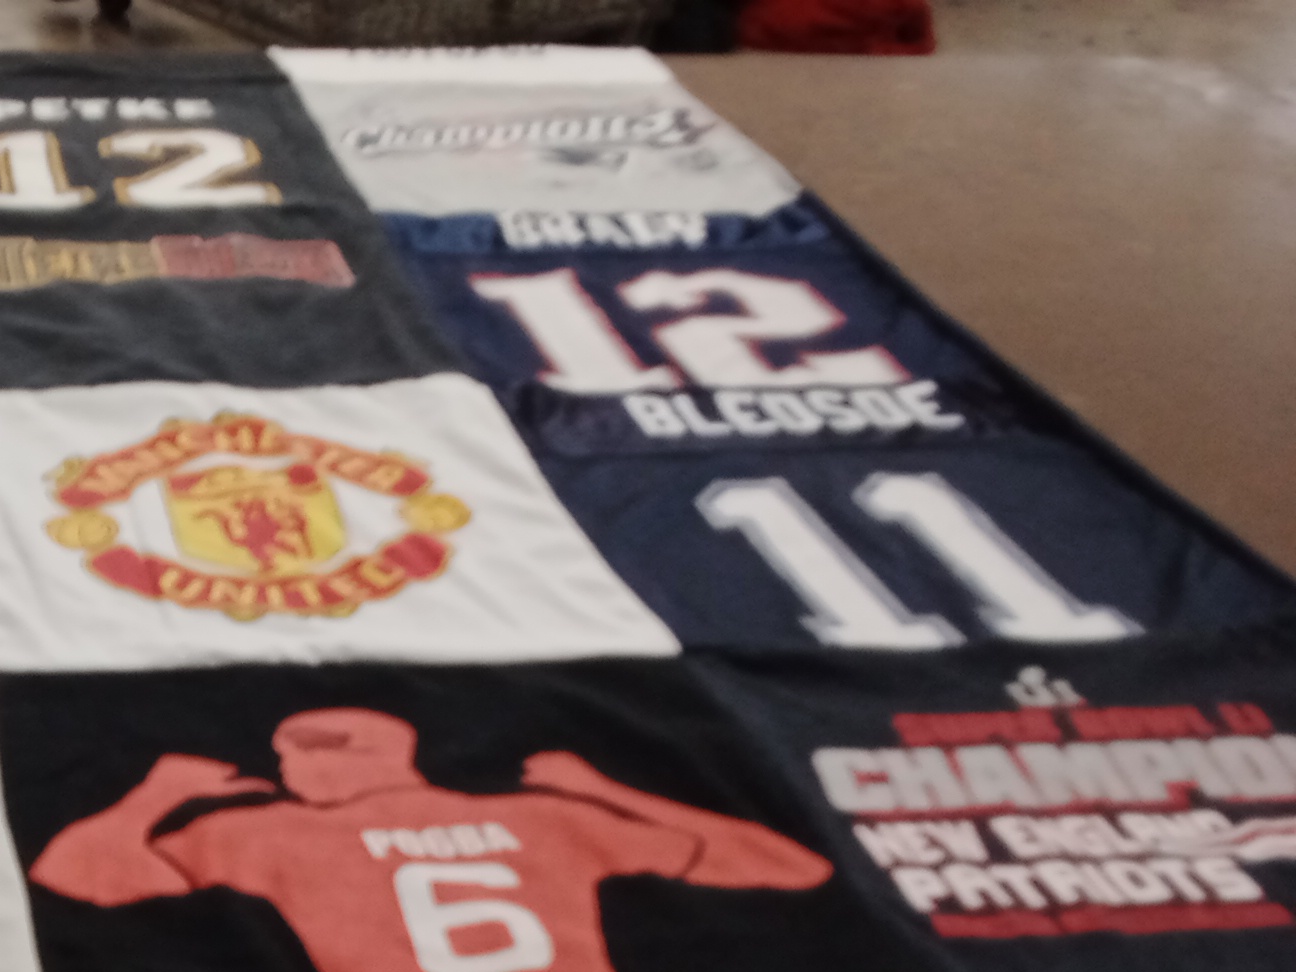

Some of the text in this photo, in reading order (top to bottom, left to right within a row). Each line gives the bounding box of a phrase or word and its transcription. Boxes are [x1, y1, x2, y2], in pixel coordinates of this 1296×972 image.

[467, 268, 912, 396] 12
[694, 472, 1146, 651] 11
[891, 856, 1266, 914] PATRIOTS
